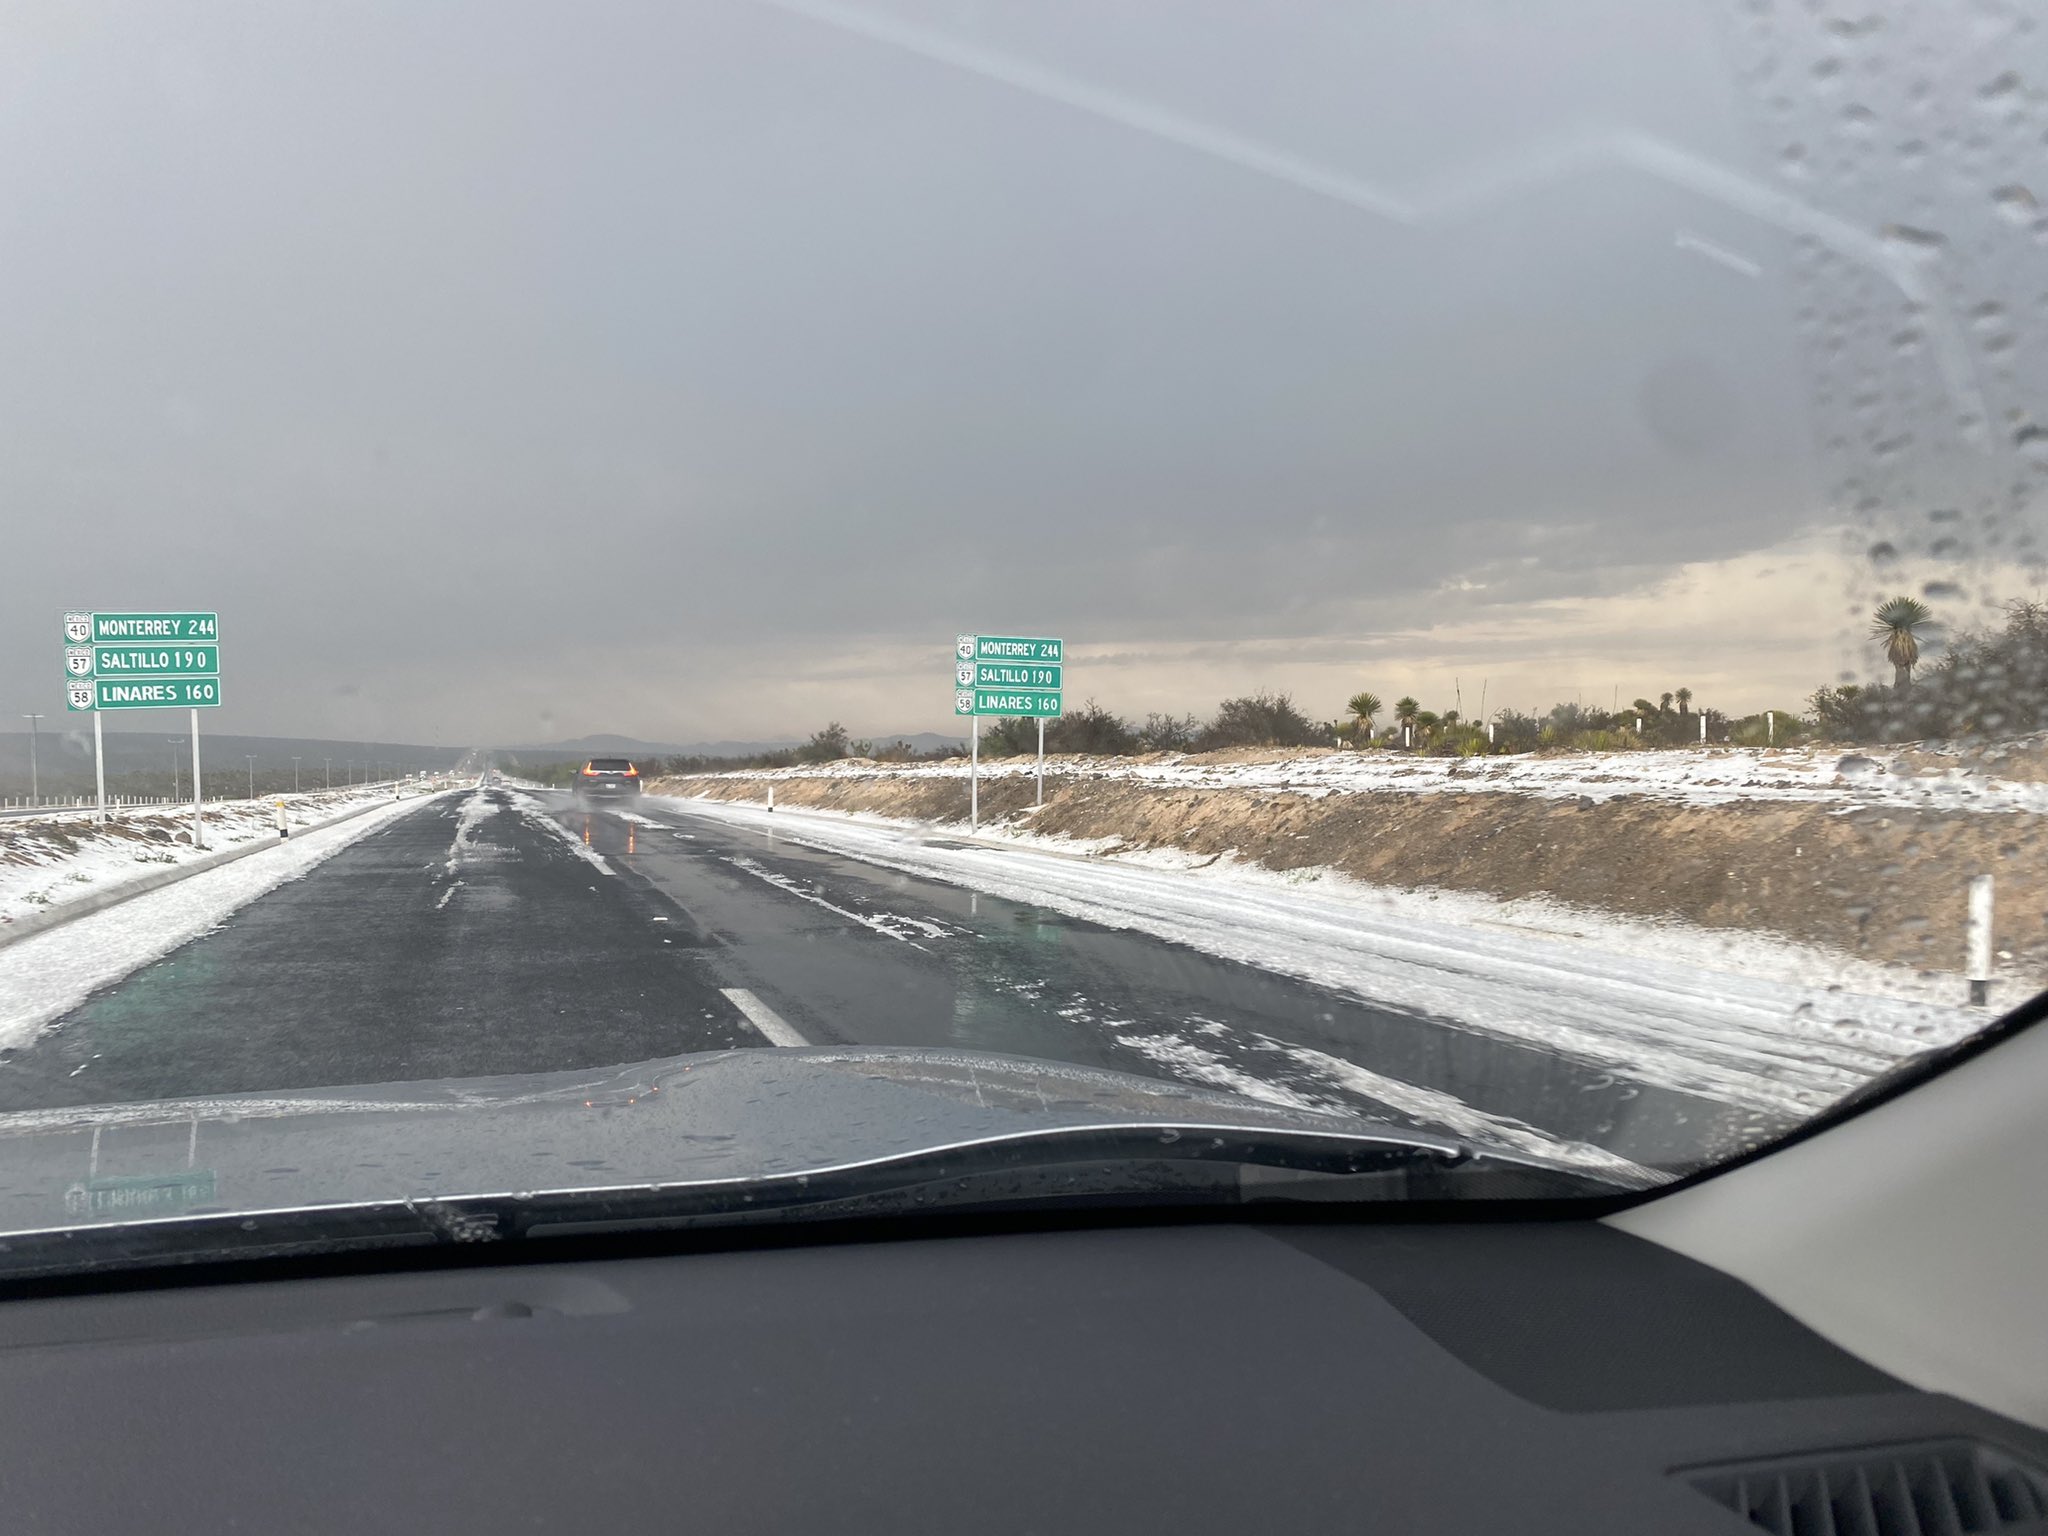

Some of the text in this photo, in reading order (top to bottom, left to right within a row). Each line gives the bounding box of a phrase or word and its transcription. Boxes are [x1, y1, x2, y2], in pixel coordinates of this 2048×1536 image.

[70, 625, 87, 636] 40
[99, 619, 214, 635] MONTERREY 244
[960, 645, 971, 655] 40
[981, 641, 1059, 657] MONTERREY 244
[73, 658, 87, 670] 57
[101, 652, 169, 668] SALTILLO
[175, 651, 206, 668] 190
[961, 671, 971, 681] 57
[980, 668, 1052, 684] SALTILLO 190
[74, 692, 89, 703] 58
[102, 685, 177, 701] LINARES
[185, 684, 214, 700] 160
[959, 699, 971, 709] 58
[979, 695, 1058, 711] LINARES 160
